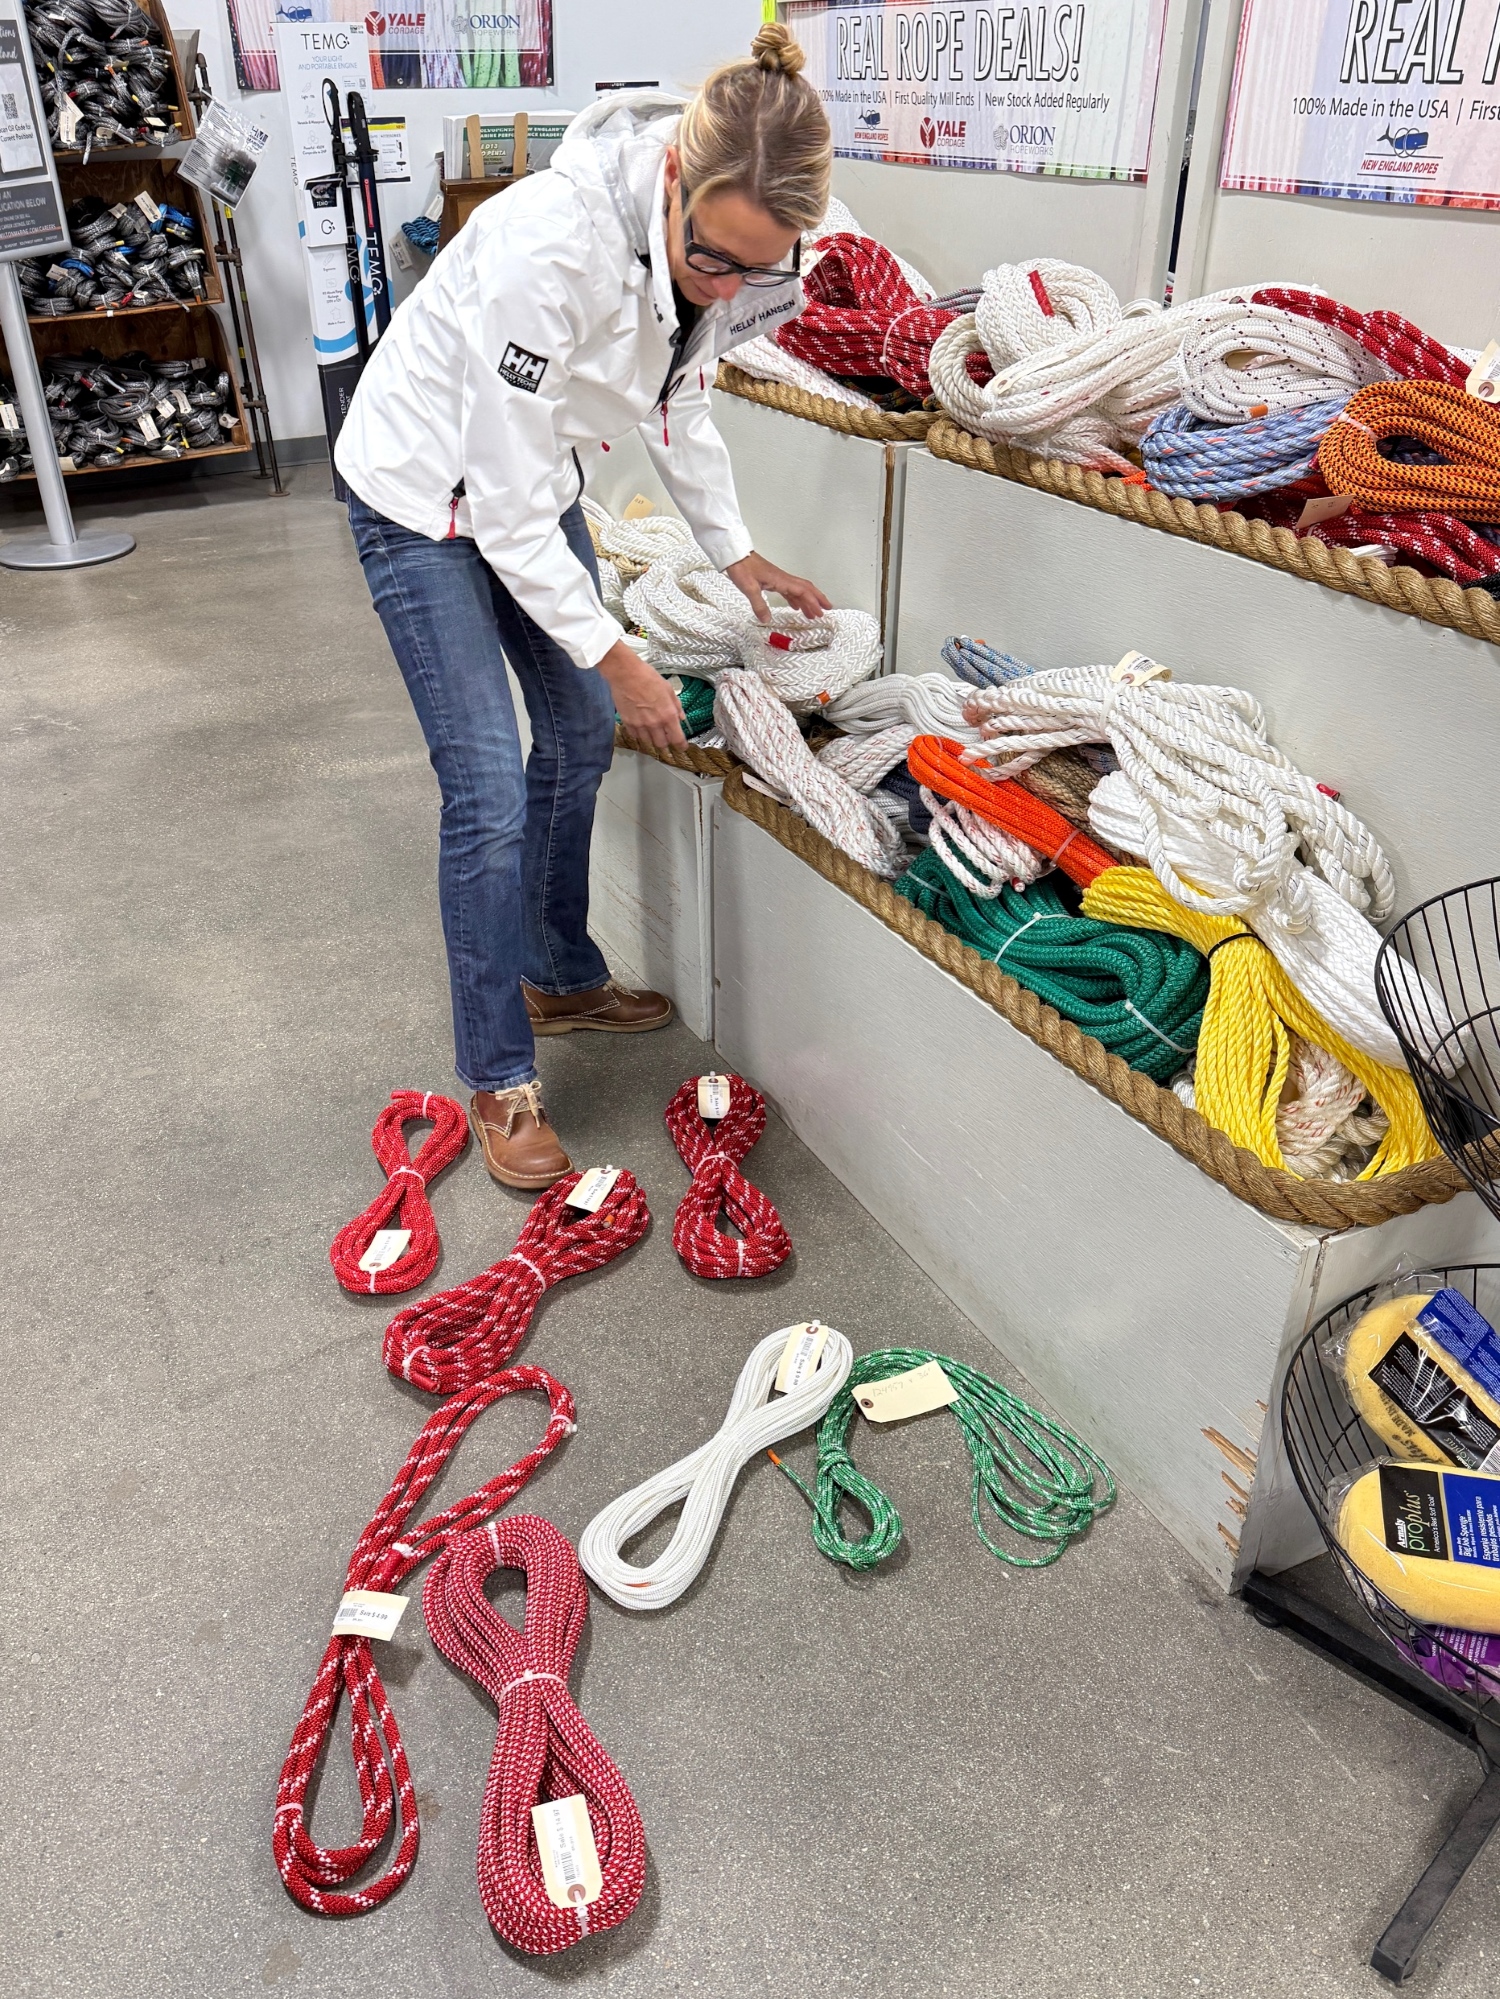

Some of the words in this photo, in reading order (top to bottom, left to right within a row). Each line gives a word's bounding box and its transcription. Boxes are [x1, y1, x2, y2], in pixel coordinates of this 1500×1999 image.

[388, 13, 426, 26] YALE
[470, 14, 521, 29] ORION
[388, 27, 425, 35] CORDAGE
[300, 33, 350, 50] TEMO
[837, 15, 889, 81] REAL
[896, 10, 965, 82] ROPE
[973, 4, 1085, 82] DEALS!
[1340, 0, 1465, 84] REAL
[311, 62, 337, 70] PORTABLE
[835, 90, 852, 103] Made
[852, 90, 859, 103] in
[860, 90, 871, 103] the
[872, 91, 887, 104] USA
[895, 91, 910, 105] First
[911, 91, 937, 109] Quality
[939, 91, 954, 106] Mill
[956, 92, 975, 106] Ends
[985, 92, 1005, 107] New
[1007, 92, 1032, 107] Stock
[1034, 92, 1064, 109] Added
[1066, 92, 1110, 113] Regularly
[1293, 97, 1326, 116] 100%
[1329, 97, 1368, 117] Made
[1371, 98, 1385, 117] in
[1389, 98, 1414, 118] the
[1418, 99, 1449, 118] USA
[937, 120, 966, 138] YALE
[1010, 125, 1056, 145] ORION
[937, 138, 966, 147] CORDAGE
[1010, 145, 1053, 155] ROPEWORKS
[1361, 159, 1378, 171] NEW
[1379, 160, 1412, 173] ENGLAND
[1413, 162, 1439, 174] ROPES
[26, 197, 46, 208] BELOW
[346, 222, 360, 284] TEMO
[366, 232, 383, 296] TEMO
[729, 316, 756, 336] HELLY
[758, 299, 796, 322] HANSEN
[339, 387, 347, 415] TENDER
[1390, 1407, 1401, 1420] IN
[1399, 1418, 1416, 1437] MADE
[1475, 1496, 1483, 1510] para
[1478, 1510, 1489, 1542] resistente
[1486, 1513, 1494, 1534] pesados
[1397, 1517, 1408, 1549] Armaly
[1462, 1534, 1471, 1548] Job
[1463, 1547, 1472, 1558] Big
[1482, 1542, 1491, 1561] Esponja
